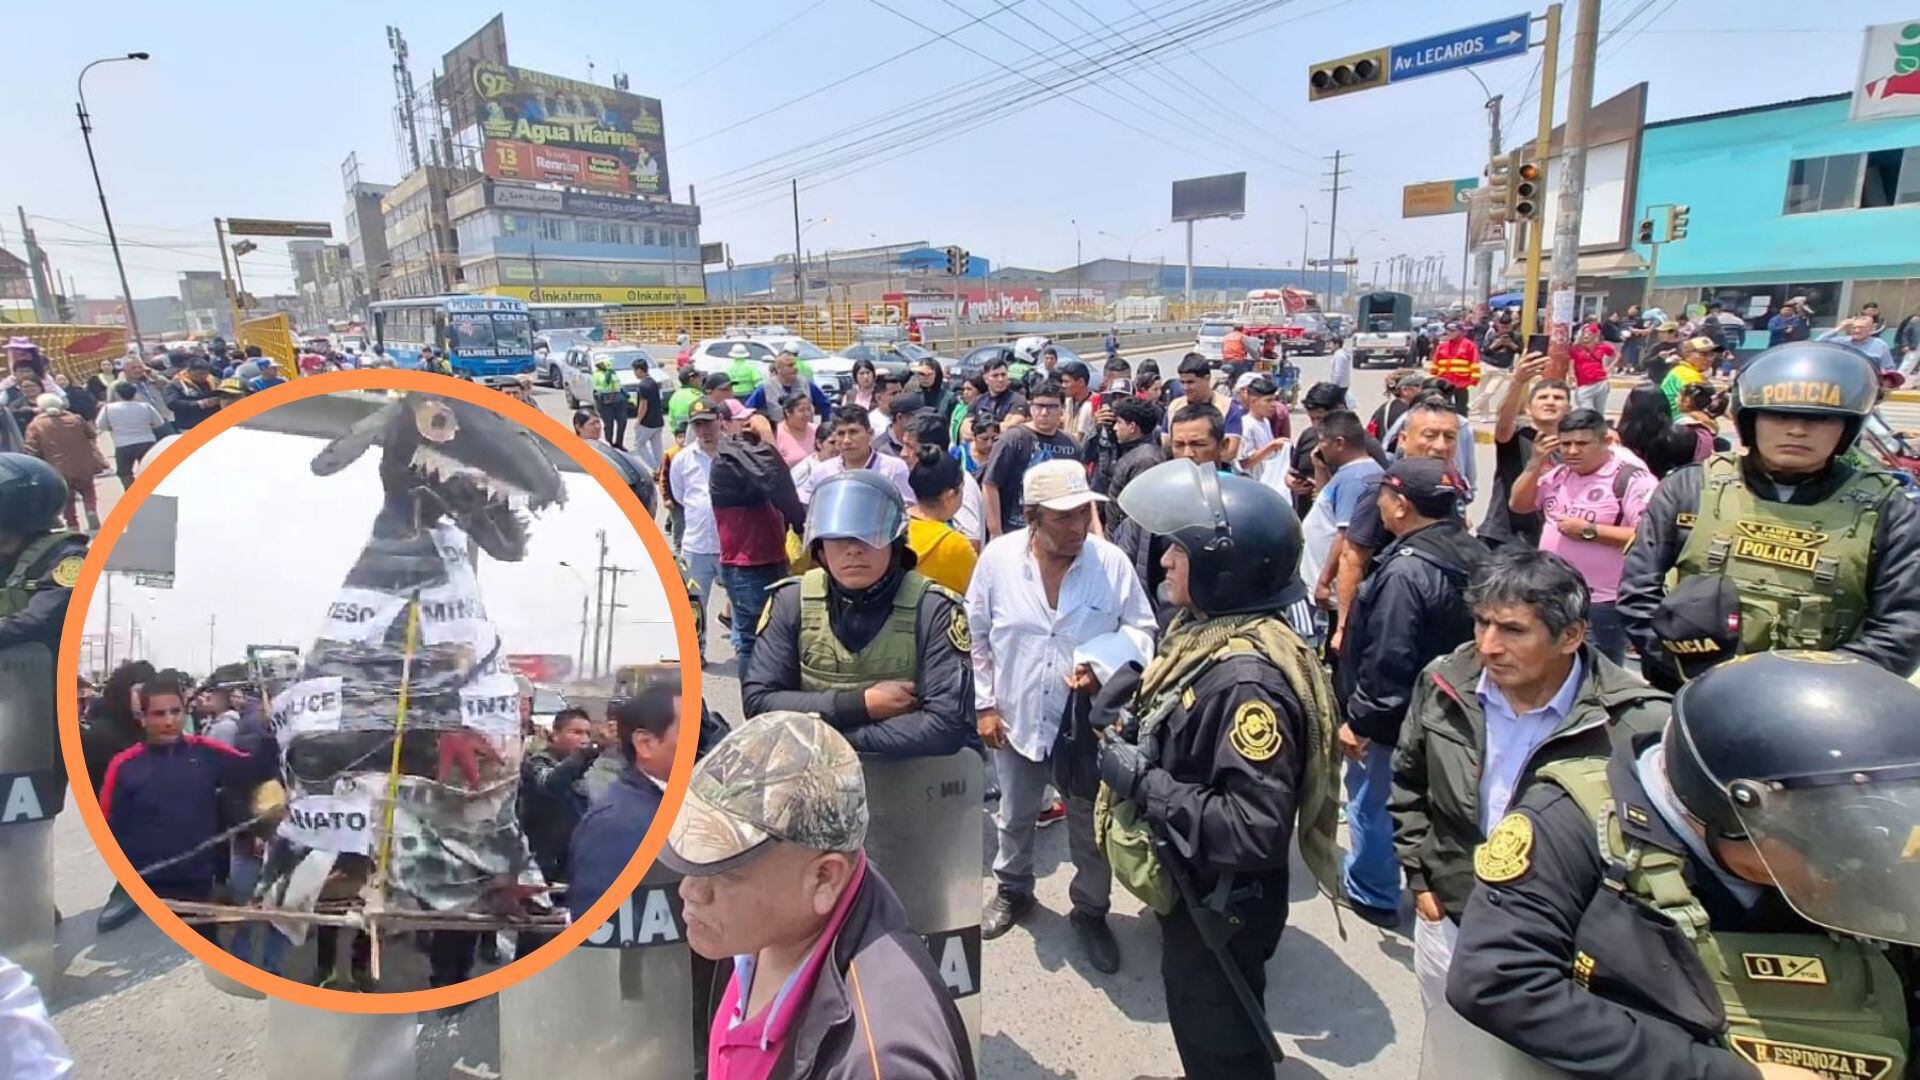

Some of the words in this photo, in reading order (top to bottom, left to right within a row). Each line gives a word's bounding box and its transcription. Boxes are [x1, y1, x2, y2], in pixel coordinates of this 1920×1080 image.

[1394, 55, 1415, 71] Av.
[1416, 36, 1485, 67] LECAROS
[515, 117, 570, 144] Agua
[574, 122, 639, 147] Marina
[497, 148, 518, 166] 13
[498, 300, 522, 311] ATE
[541, 290, 602, 302] Inkafarma
[638, 290, 686, 300] Inkafarma
[1002, 292, 1039, 315] Piedra
[1763, 382, 1840, 405] POLICIA
[1741, 540, 1810, 566] POLICIA
[1775, 1047, 1851, 1074] ESPINOZA
